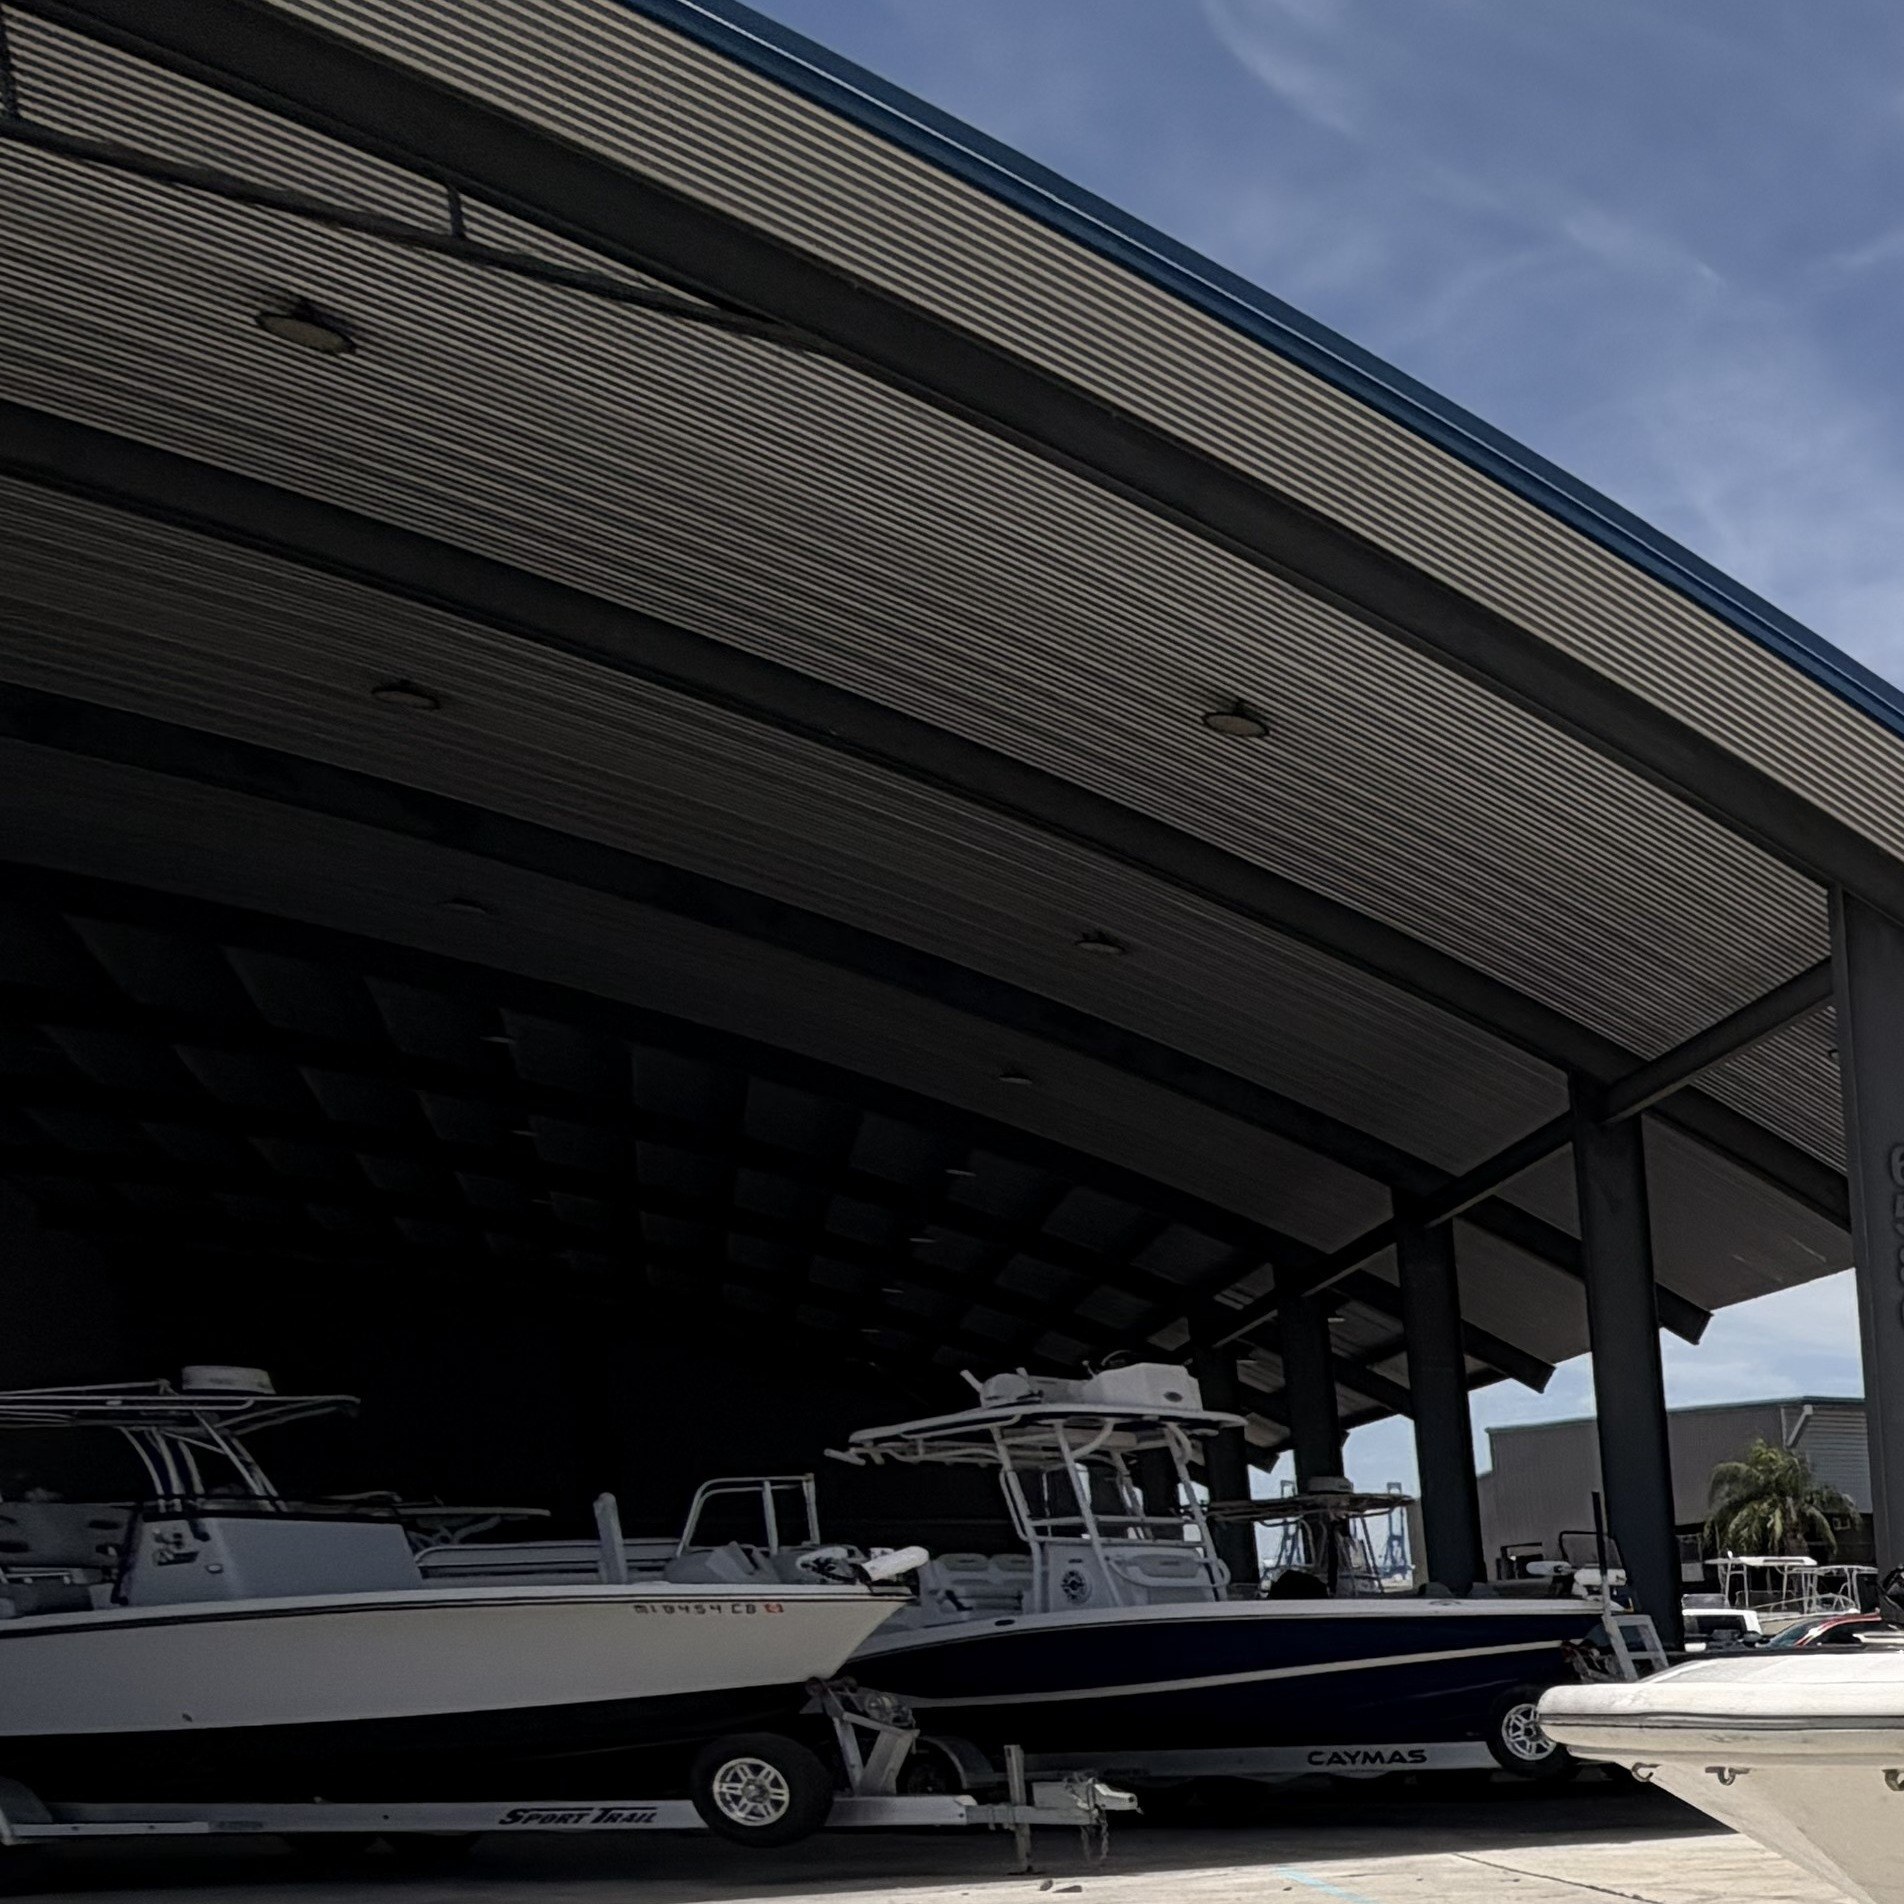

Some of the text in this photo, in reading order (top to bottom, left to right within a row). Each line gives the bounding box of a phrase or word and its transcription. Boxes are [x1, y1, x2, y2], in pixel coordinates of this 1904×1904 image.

[1307, 1749, 1428, 1766] CAYMAS
[499, 1806, 658, 1825] SPORT TRAIL
